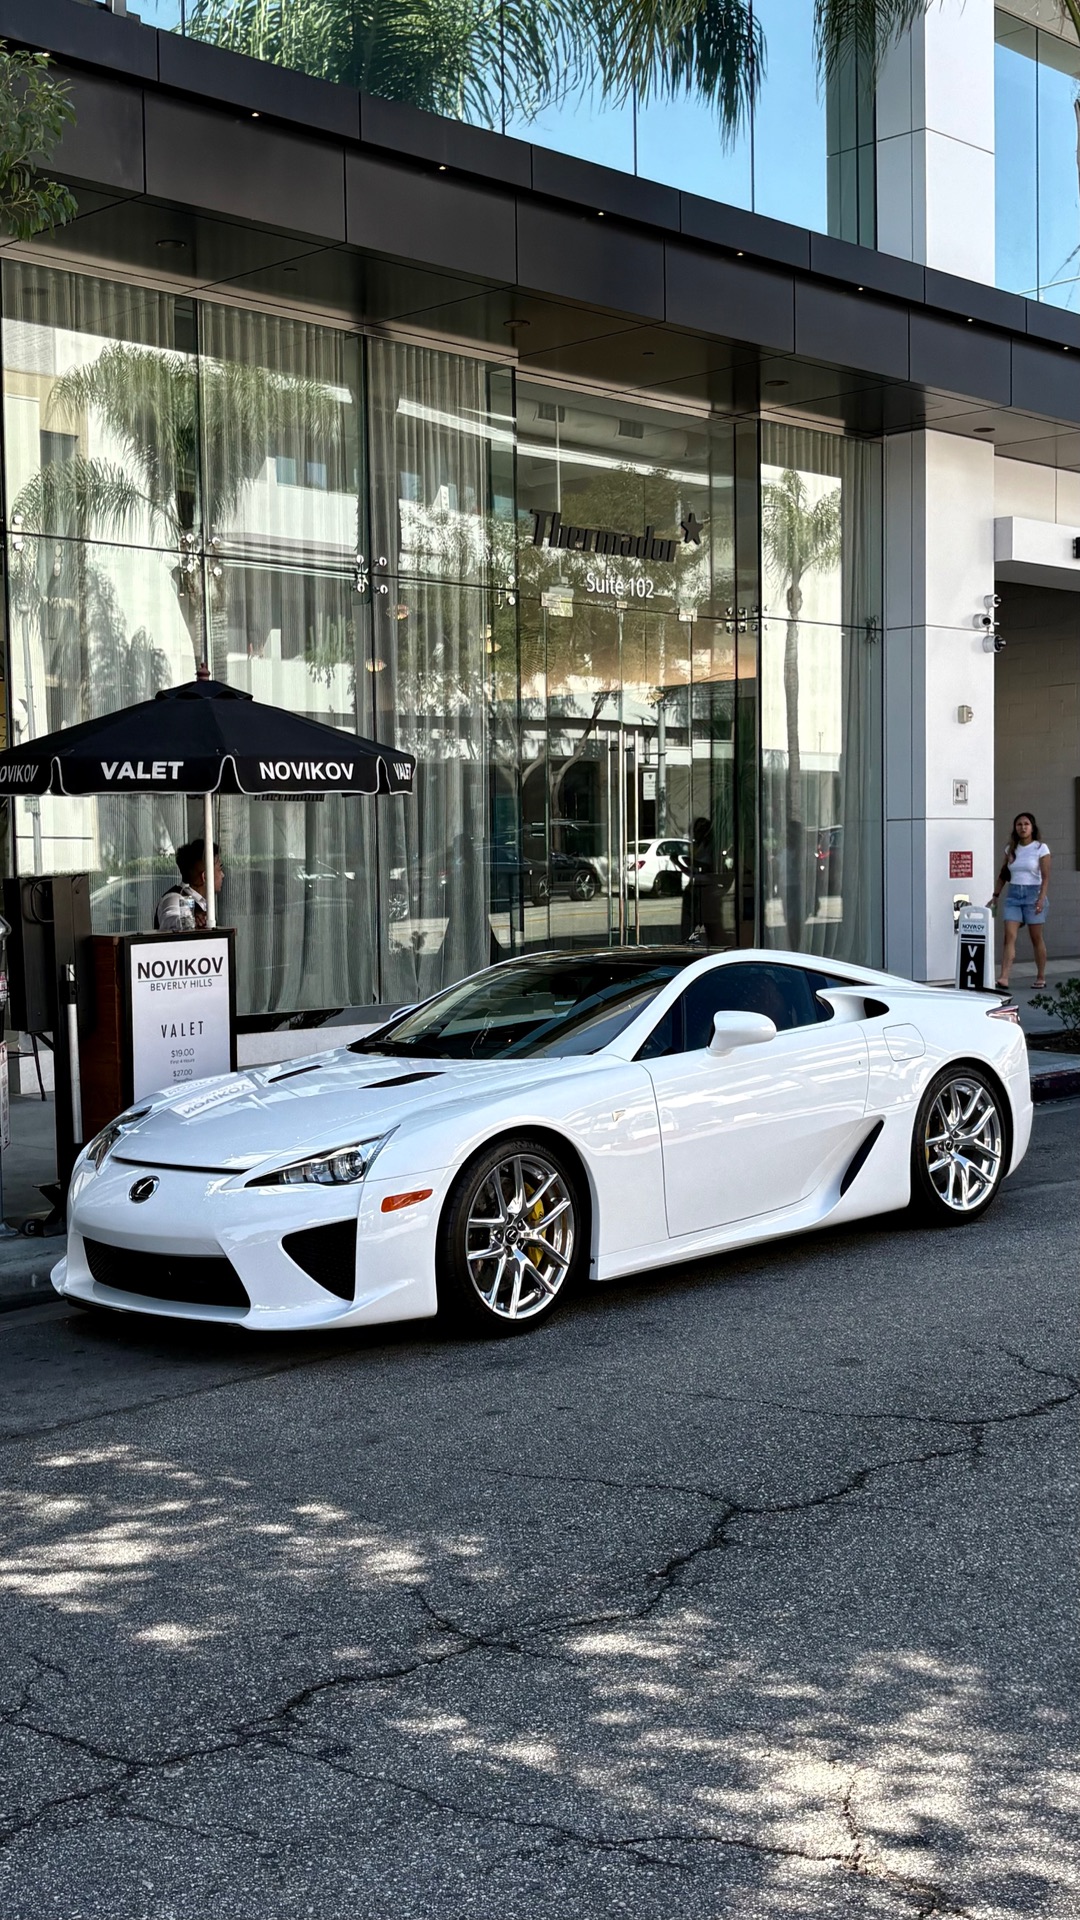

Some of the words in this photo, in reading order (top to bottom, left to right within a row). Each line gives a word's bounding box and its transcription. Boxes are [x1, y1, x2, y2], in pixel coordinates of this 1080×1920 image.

[530, 508, 681, 563] Thermador
[586, 572, 624, 596] Suite
[629, 577, 655, 599] 102
[0, 764, 39, 782] OVIKOV
[100, 761, 184, 780] VALET
[260, 761, 354, 781] NOVIKOV
[393, 762, 412, 780] VALET
[137, 956, 223, 979] NOVIKOV
[150, 980, 188, 991] BEVERLY
[190, 978, 213, 988] HILLS
[161, 1021, 204, 1038] VALET
[171, 1048, 195, 1058] $19.00
[173, 1068, 193, 1077] $27.00
